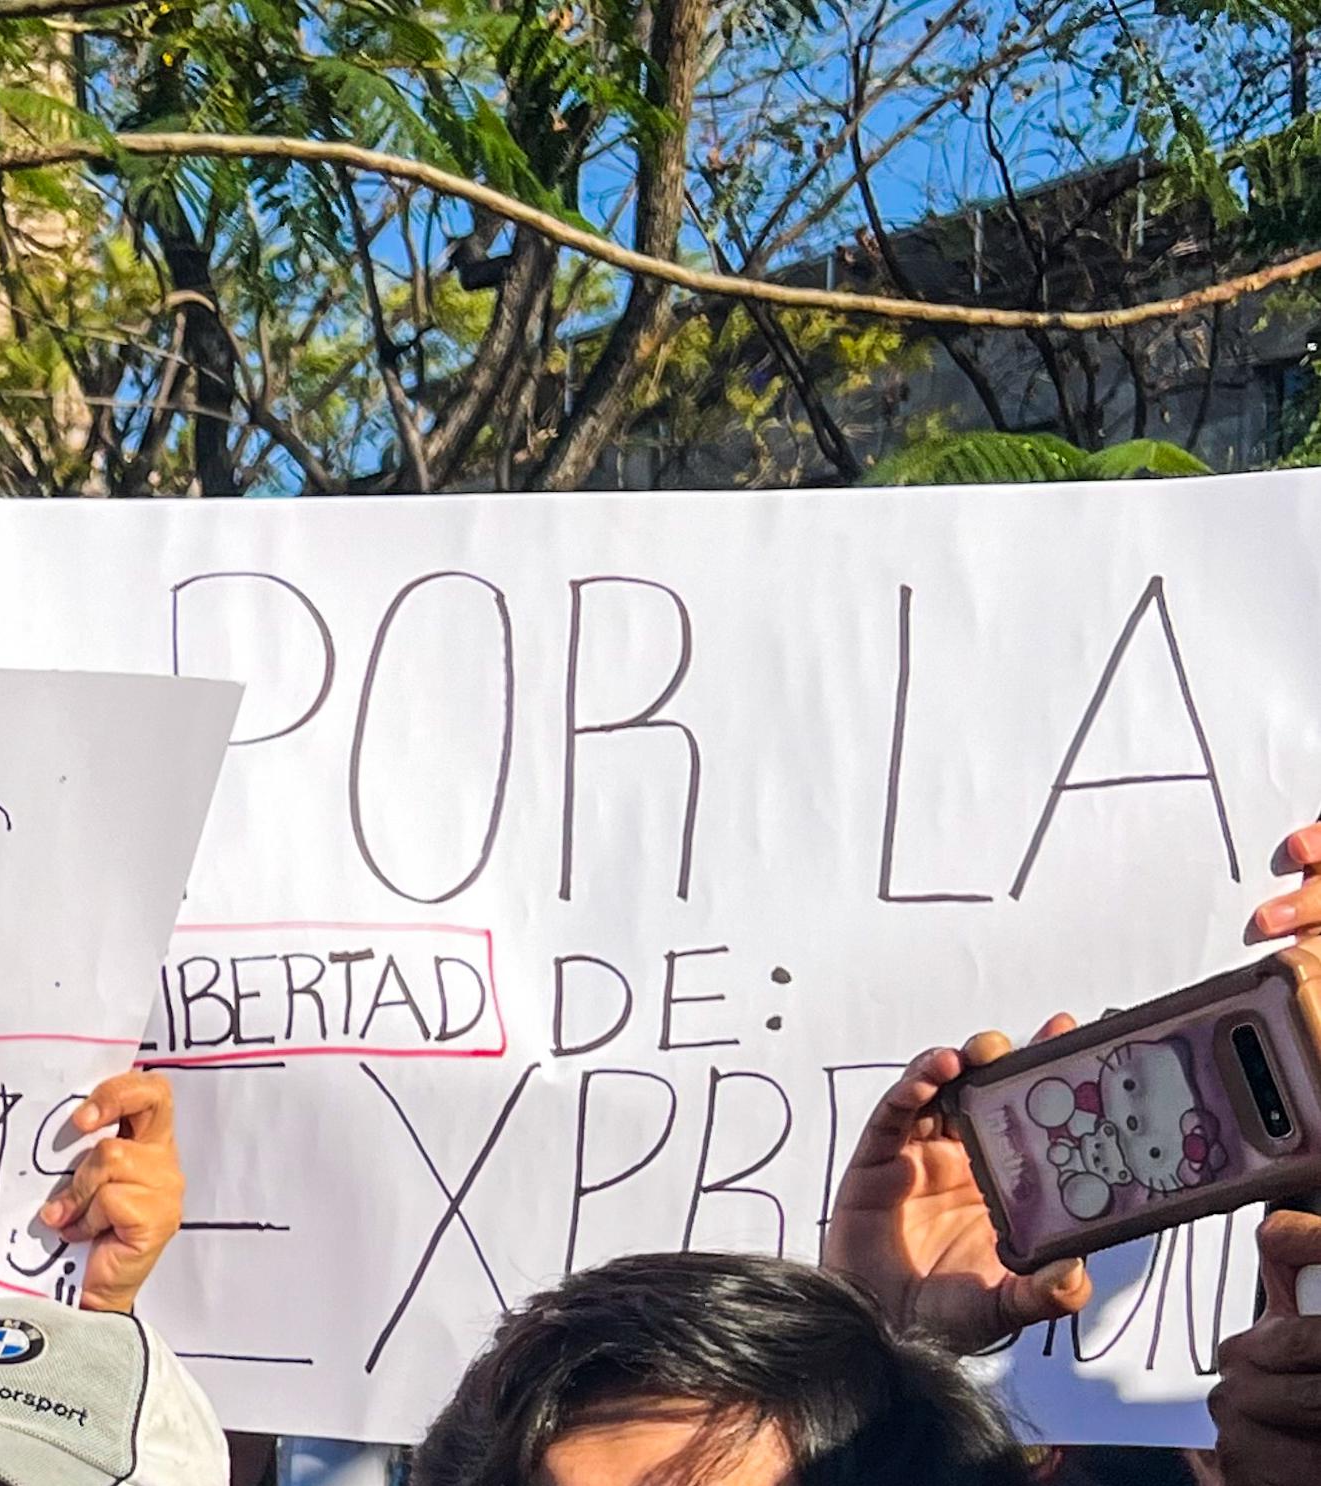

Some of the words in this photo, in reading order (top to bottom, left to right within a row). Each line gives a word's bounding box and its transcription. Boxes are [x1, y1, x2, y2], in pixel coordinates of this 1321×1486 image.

[172, 570, 700, 905] POR
[877, 574, 1241, 904] LA
[140, 948, 487, 1053] IBERTAD
